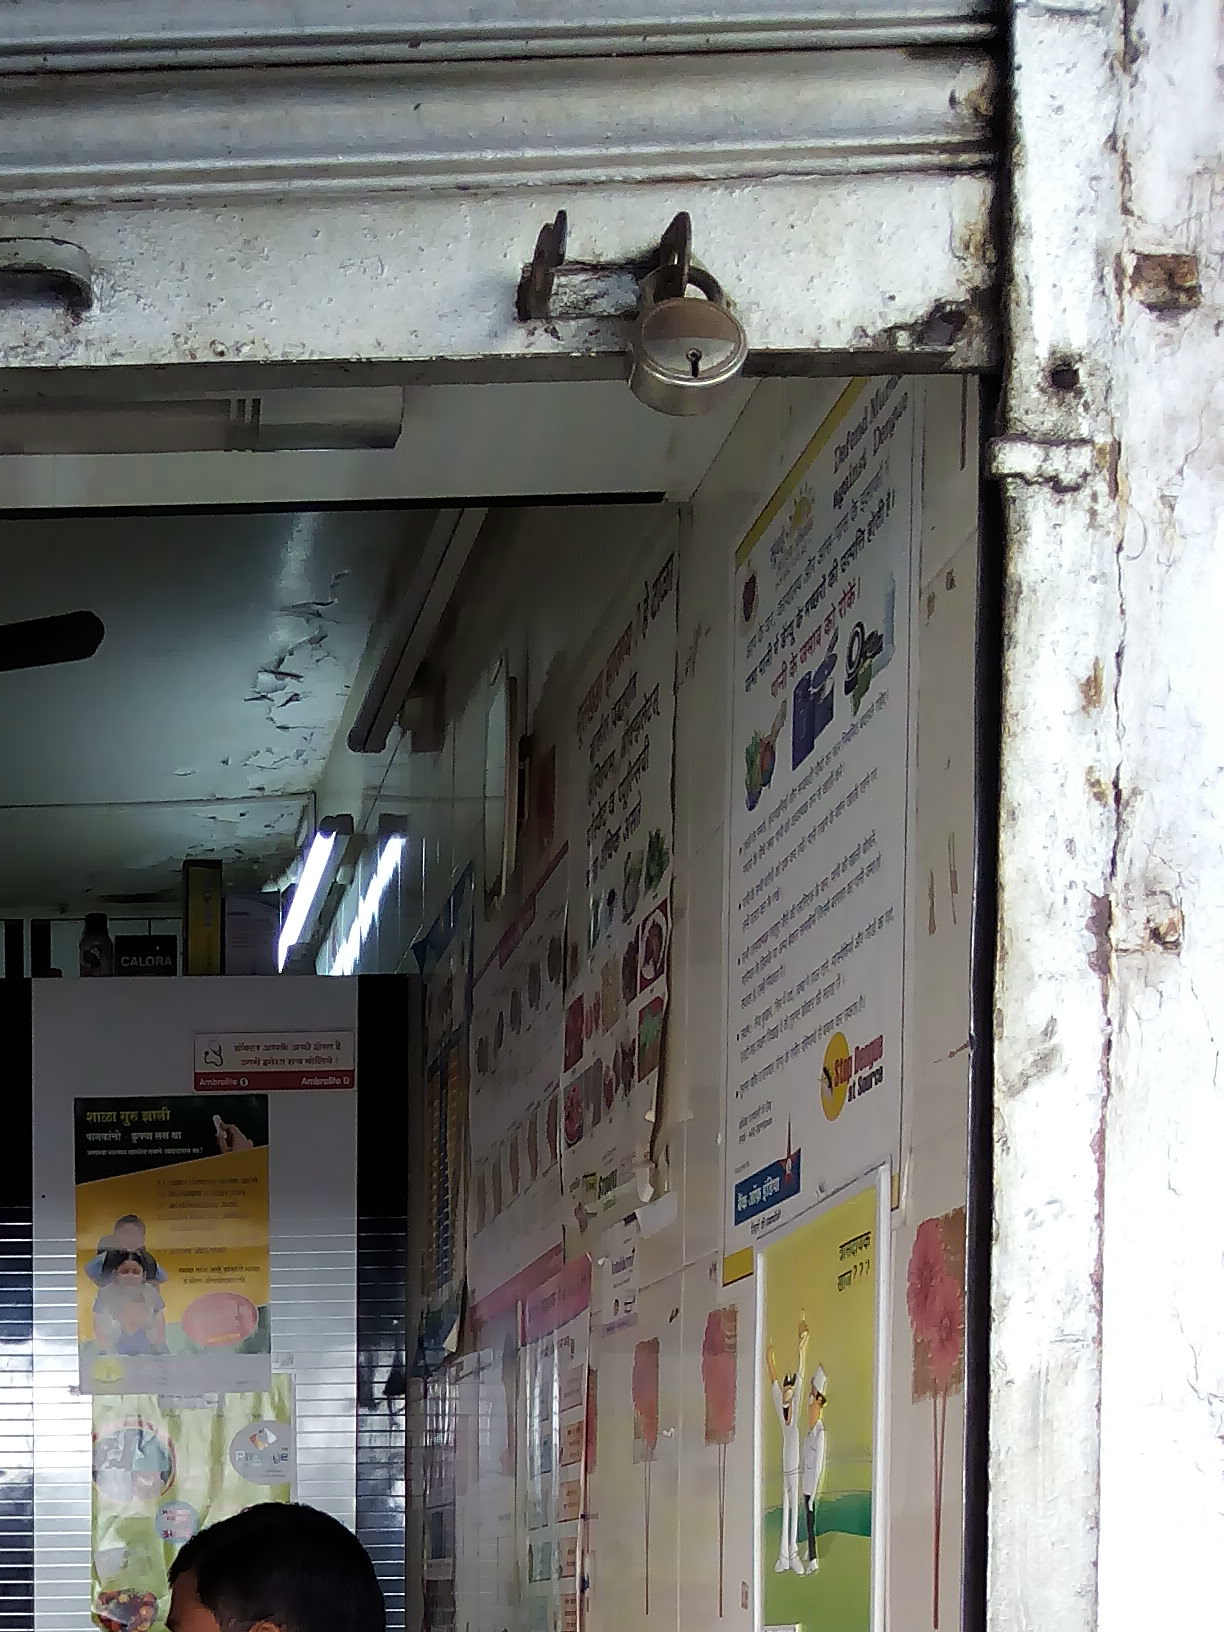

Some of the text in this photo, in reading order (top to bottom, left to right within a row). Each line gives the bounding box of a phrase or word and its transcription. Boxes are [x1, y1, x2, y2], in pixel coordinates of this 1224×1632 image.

[873, 391, 908, 457] Dengue
[120, 953, 173, 968] CALORA
[834, 1034, 884, 1088] Stop Dengue
[857, 1065, 884, 1096] Source
